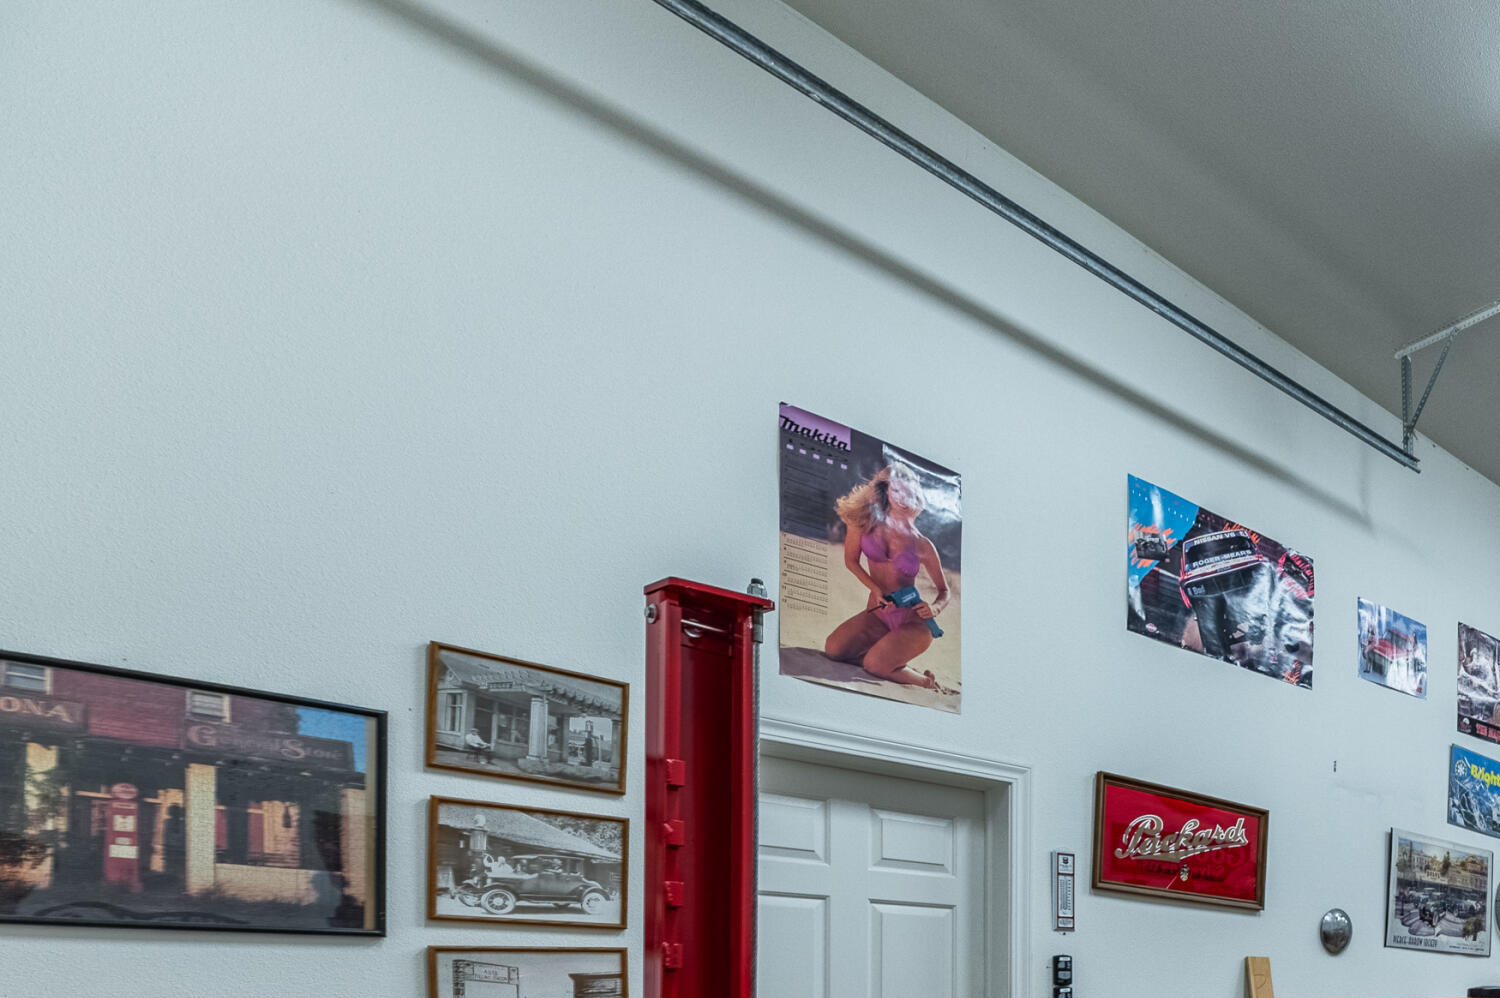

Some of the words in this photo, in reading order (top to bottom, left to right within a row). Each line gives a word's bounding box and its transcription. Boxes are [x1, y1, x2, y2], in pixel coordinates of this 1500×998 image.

[780, 415, 850, 452] Makita
[1192, 556, 1220, 568] ROGER
[1115, 815, 1248, 860] Packard
